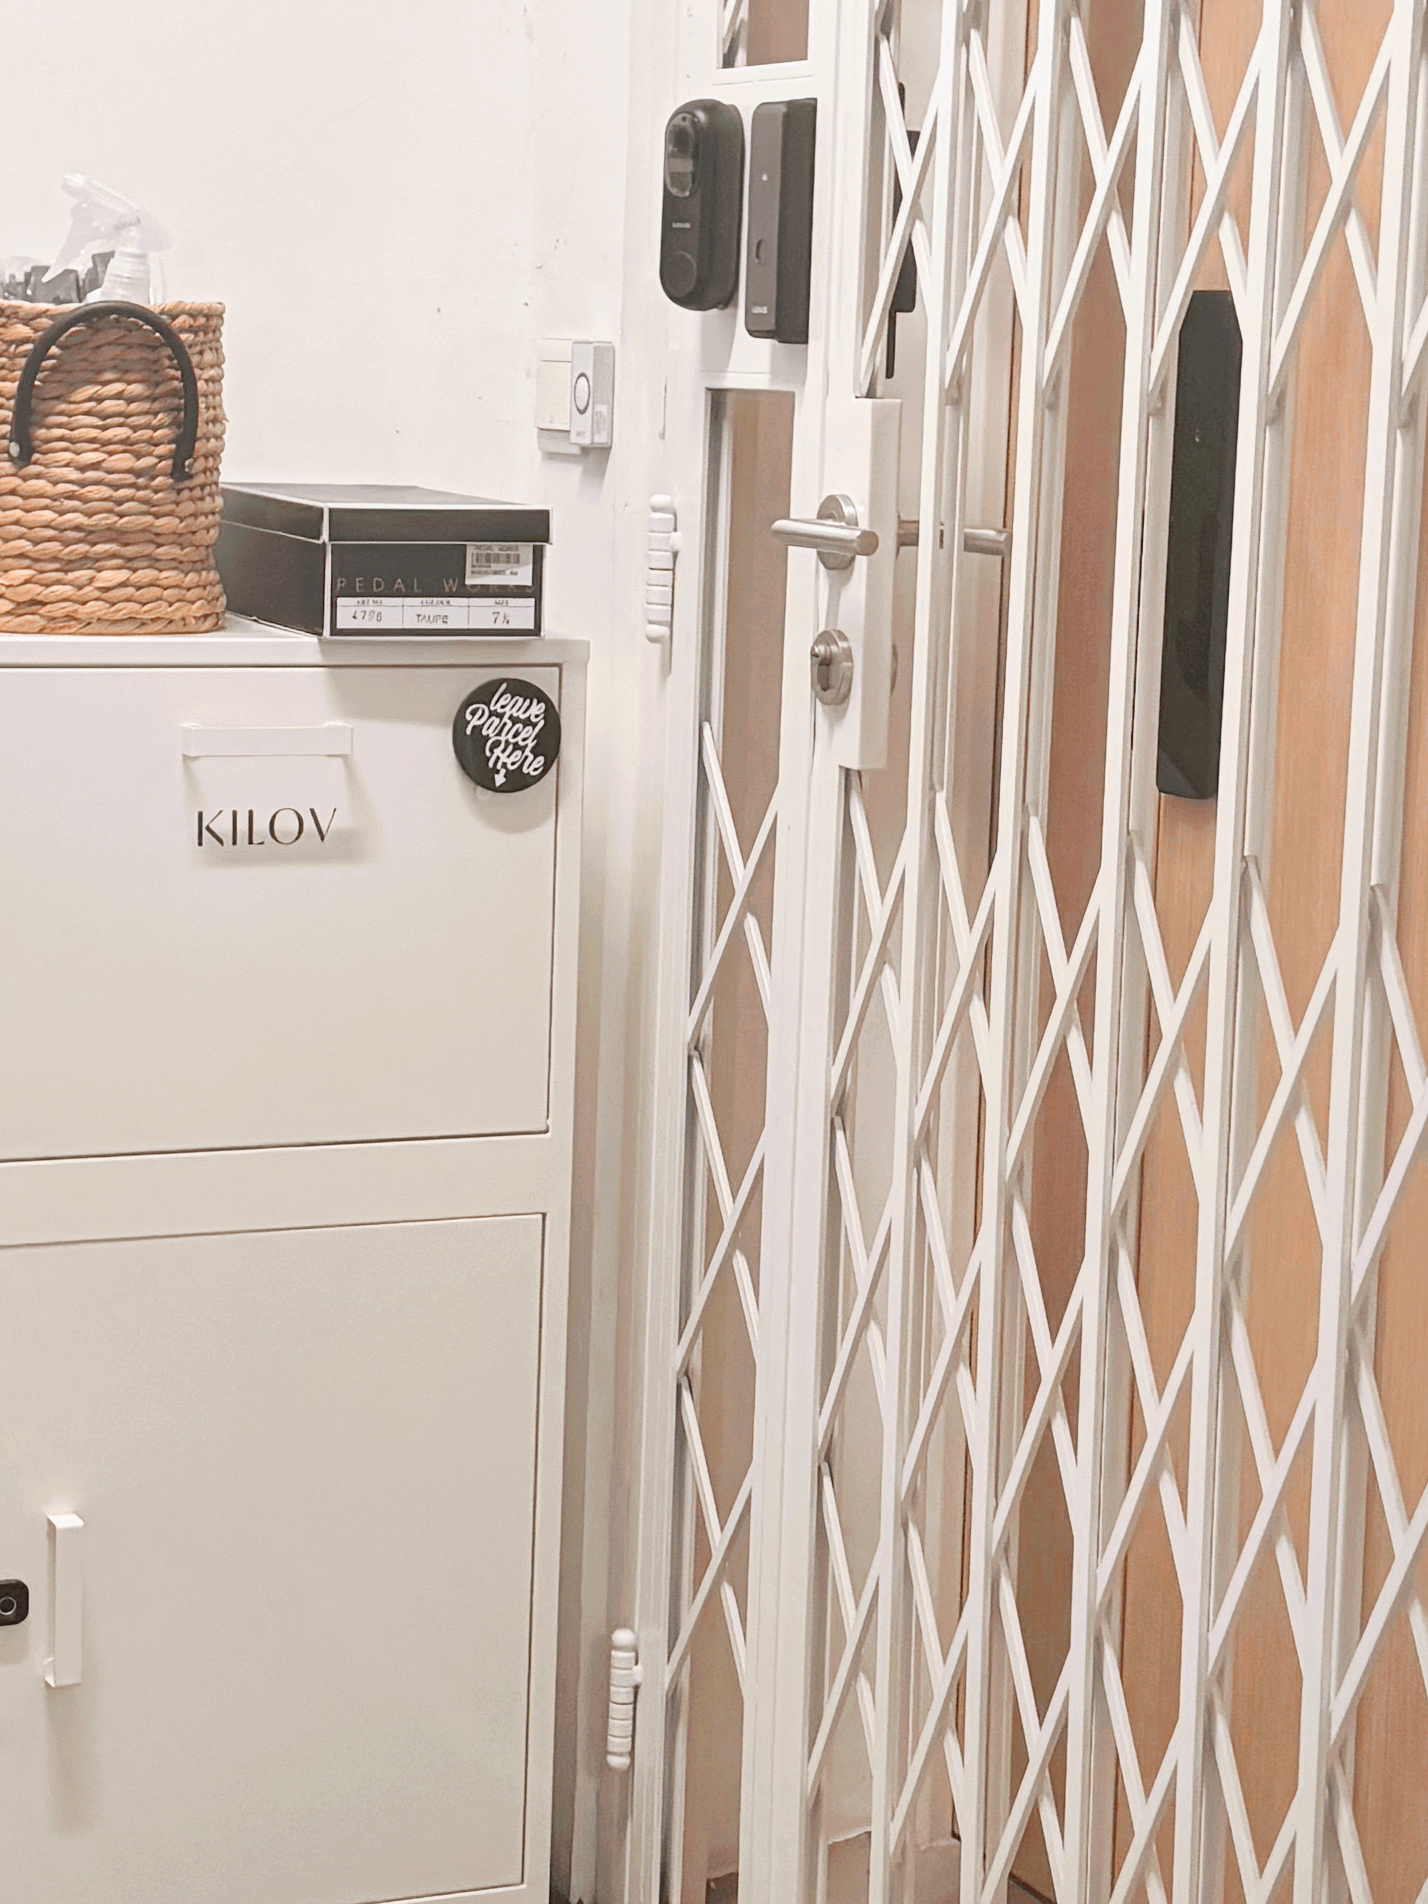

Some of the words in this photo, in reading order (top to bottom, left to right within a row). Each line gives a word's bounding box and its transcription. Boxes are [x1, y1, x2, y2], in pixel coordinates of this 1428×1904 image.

[335, 577, 423, 593] PEDAL
[464, 703, 545, 747] Parcel
[484, 736, 545, 776] Here
[196, 807, 337, 848] KILOV
